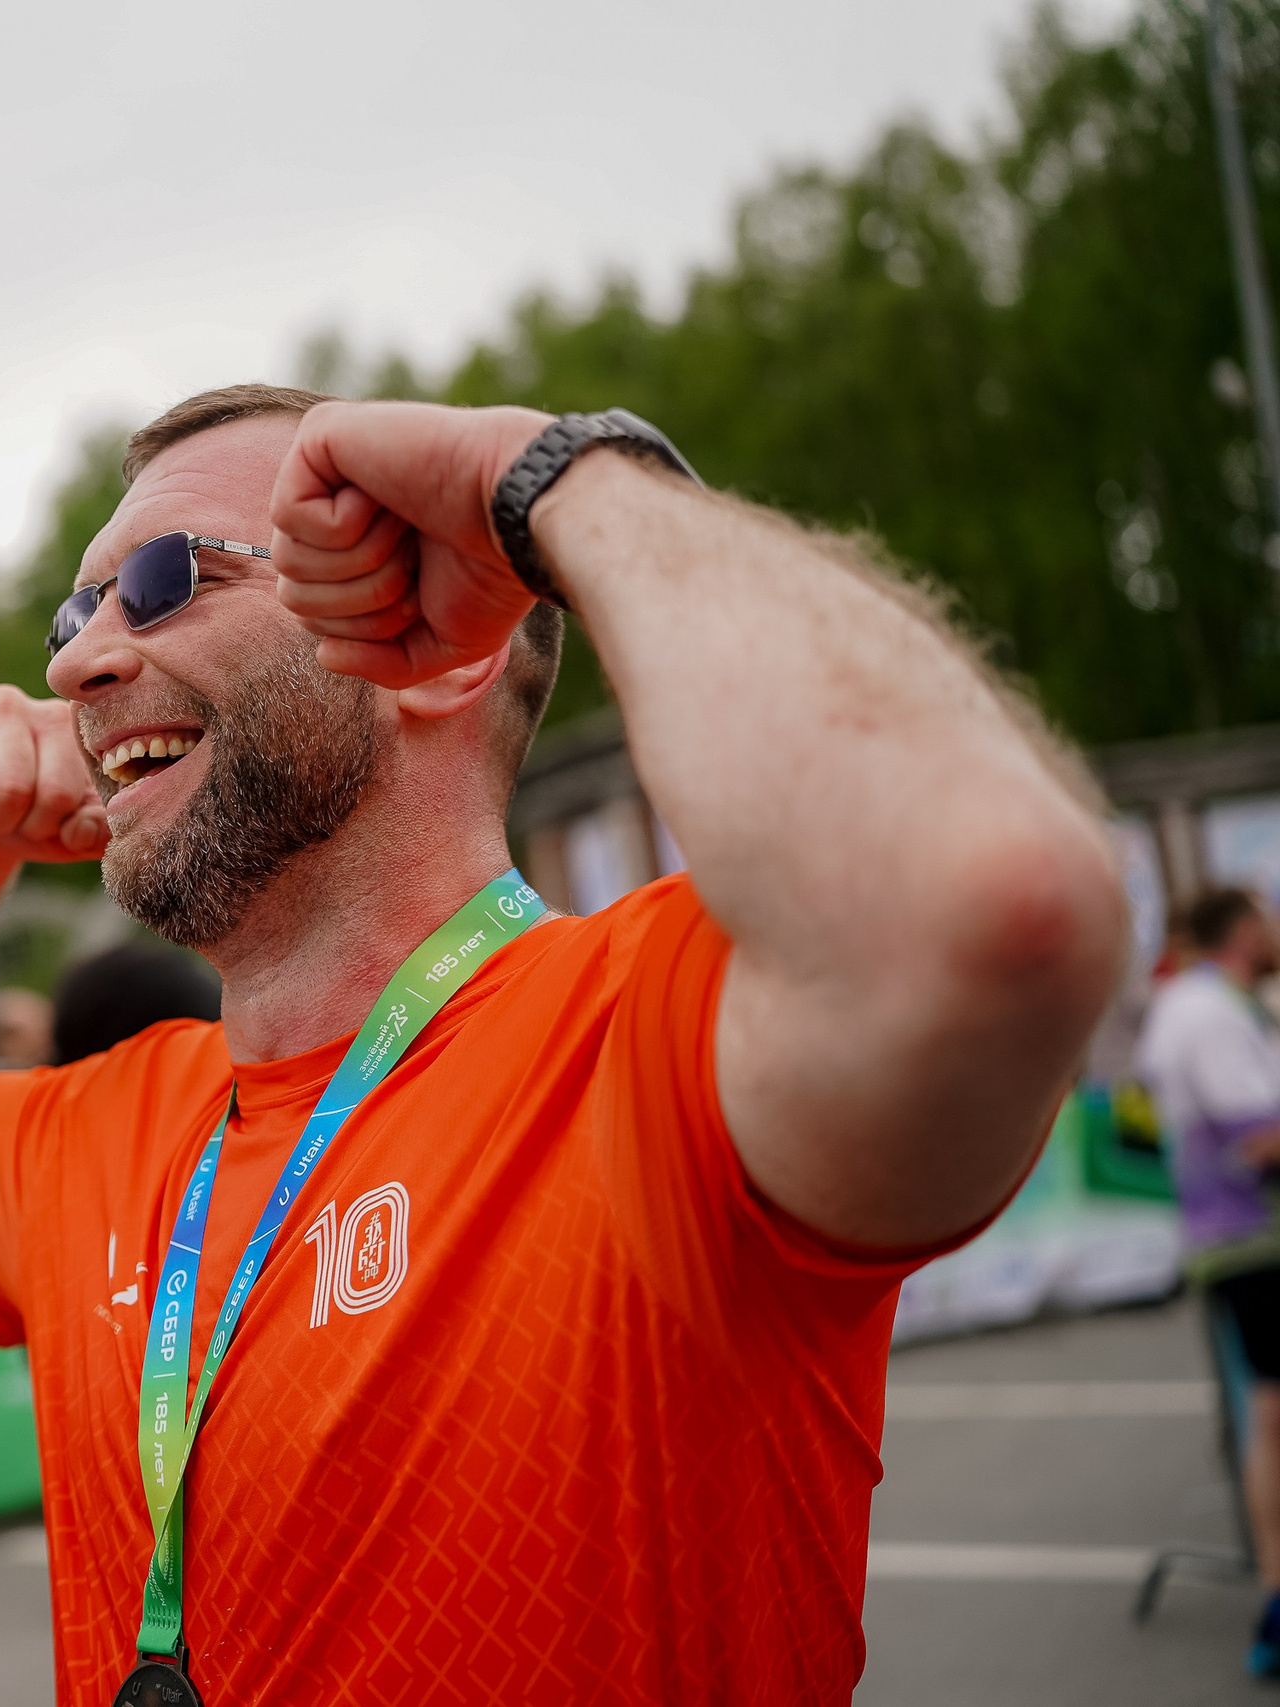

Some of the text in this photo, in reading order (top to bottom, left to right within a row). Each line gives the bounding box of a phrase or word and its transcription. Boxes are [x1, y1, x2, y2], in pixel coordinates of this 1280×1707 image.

[425, 929, 487, 983] 185 лет
[358, 1024, 390, 1073] зелёный
[362, 1033, 396, 1081] марафон
[293, 1133, 325, 1177] Utair
[186, 1181, 205, 1221] Utair
[303, 1181, 410, 1330] 10
[225, 1259, 255, 1323] СБЕР
[161, 1300, 180, 1362] СБЕР
[154, 1392, 168, 1487] 185 лет
[162, 1686, 183, 1703] Utair
